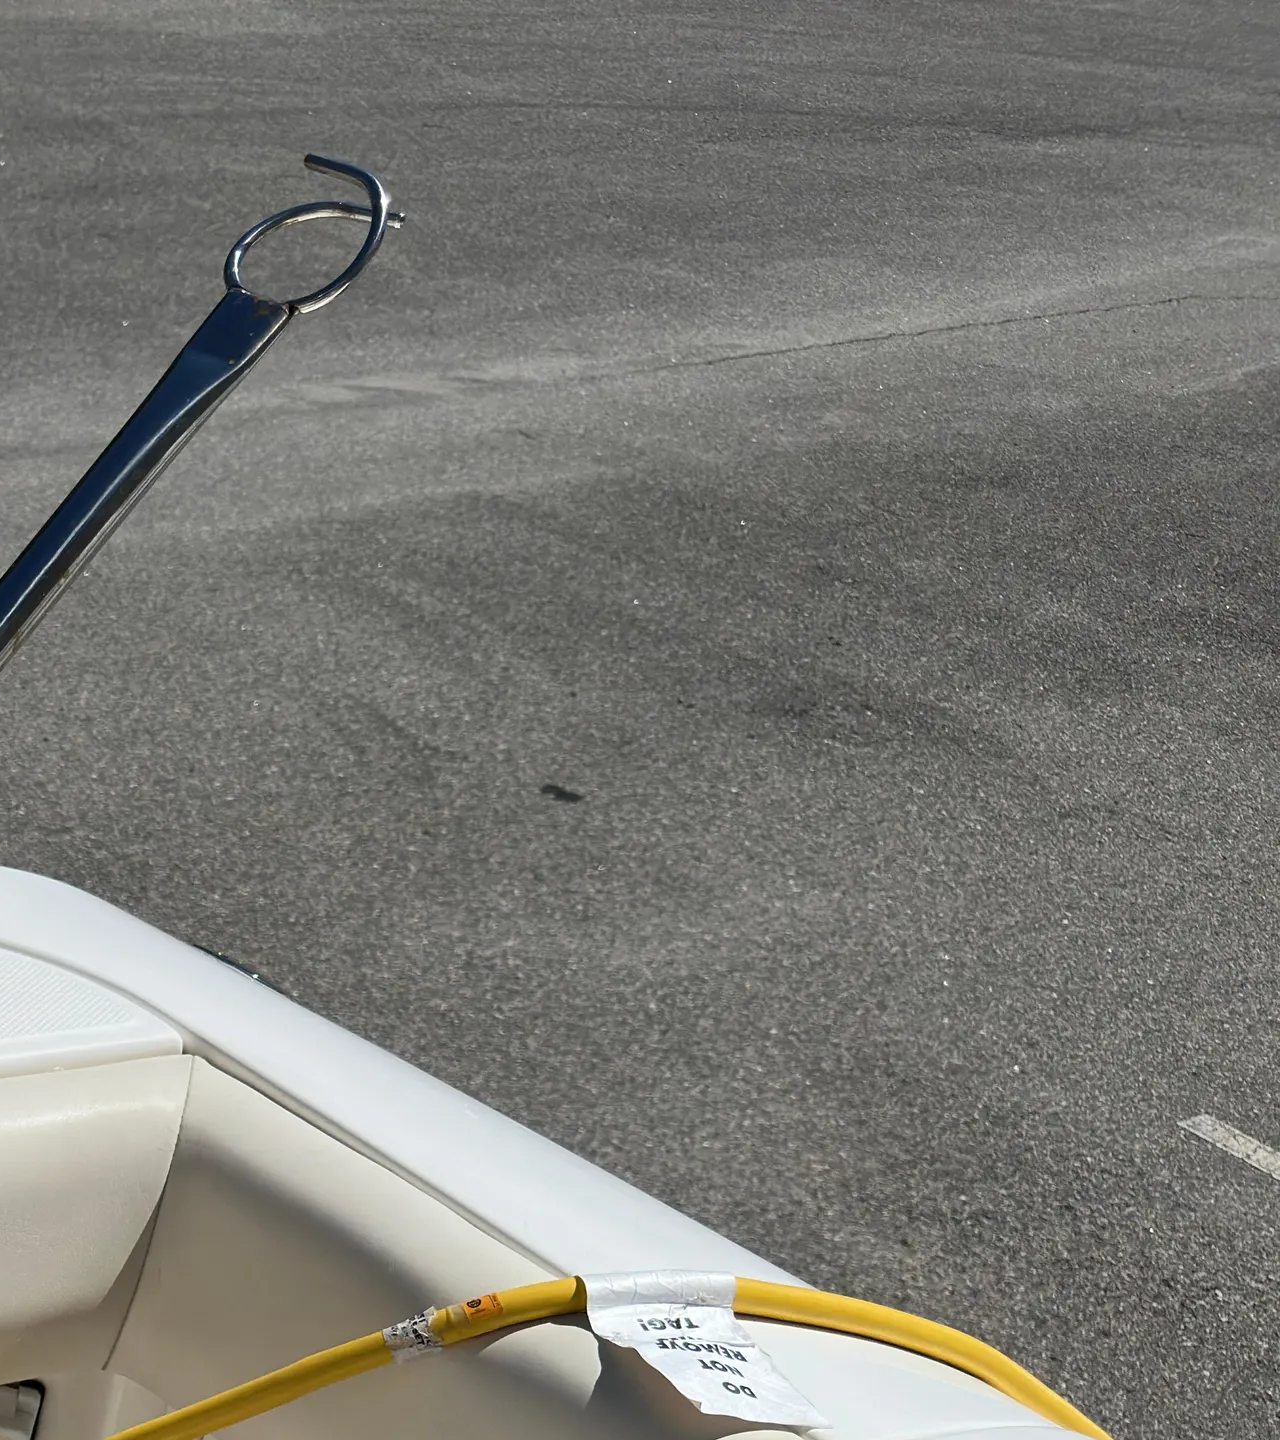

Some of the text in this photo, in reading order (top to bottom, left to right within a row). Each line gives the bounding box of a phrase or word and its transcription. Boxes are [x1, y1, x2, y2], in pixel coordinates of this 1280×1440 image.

[637, 1318, 700, 1331] TAG!
[697, 1359, 745, 1378] NOT
[722, 1382, 758, 1399] DO
